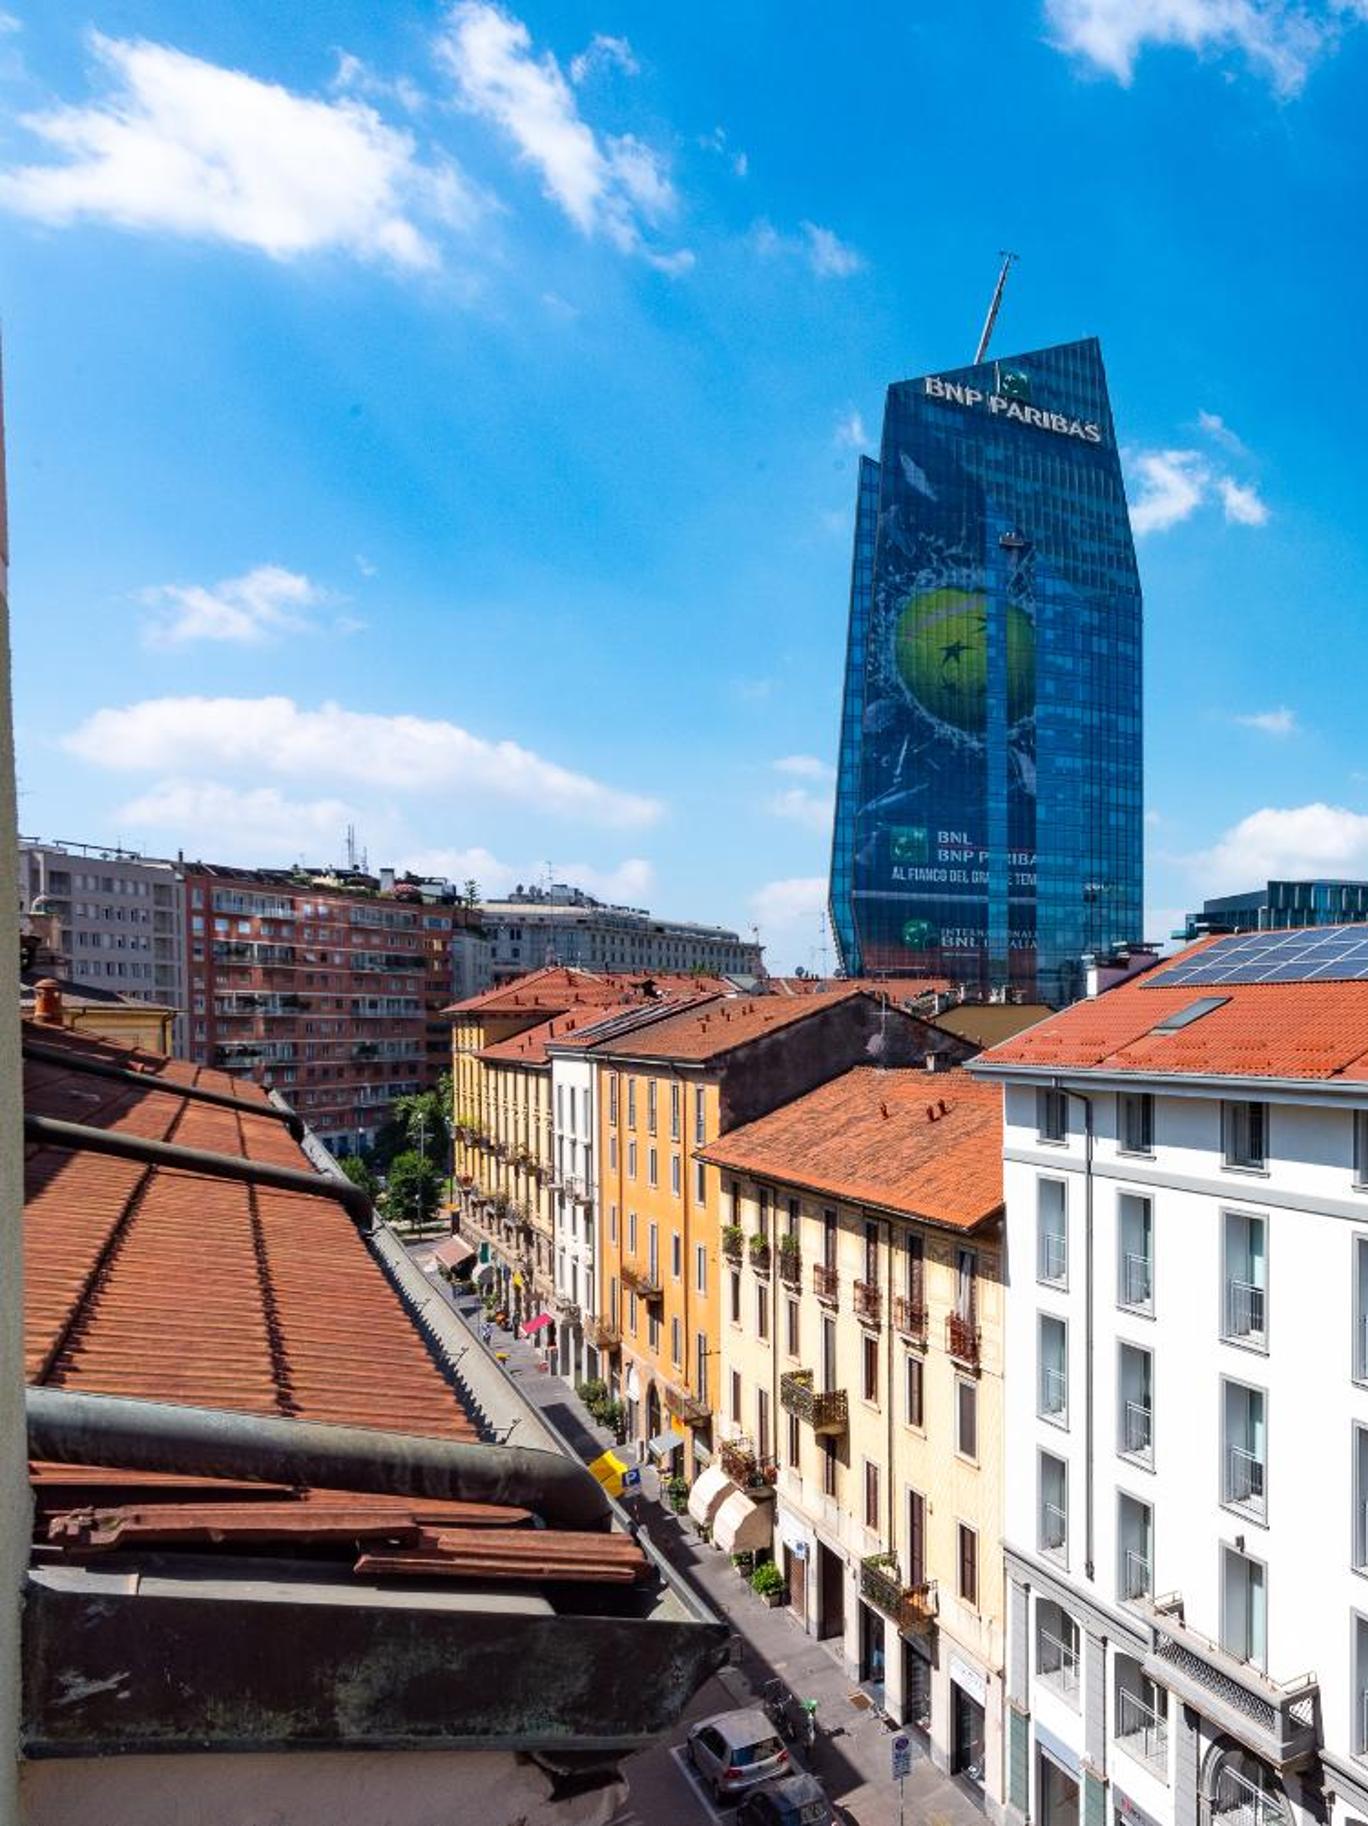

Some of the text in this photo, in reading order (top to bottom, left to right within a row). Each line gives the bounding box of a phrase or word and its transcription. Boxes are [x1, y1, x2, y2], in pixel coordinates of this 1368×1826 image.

[924, 376, 1101, 442] BNP PARIBAS
[938, 831, 973, 845] BNL
[938, 849, 974, 863] BNP
[892, 866, 906, 880] AL
[908, 867, 947, 882] FIANCO
[950, 869, 969, 883] DEL
[626, 1472, 637, 1484] P
